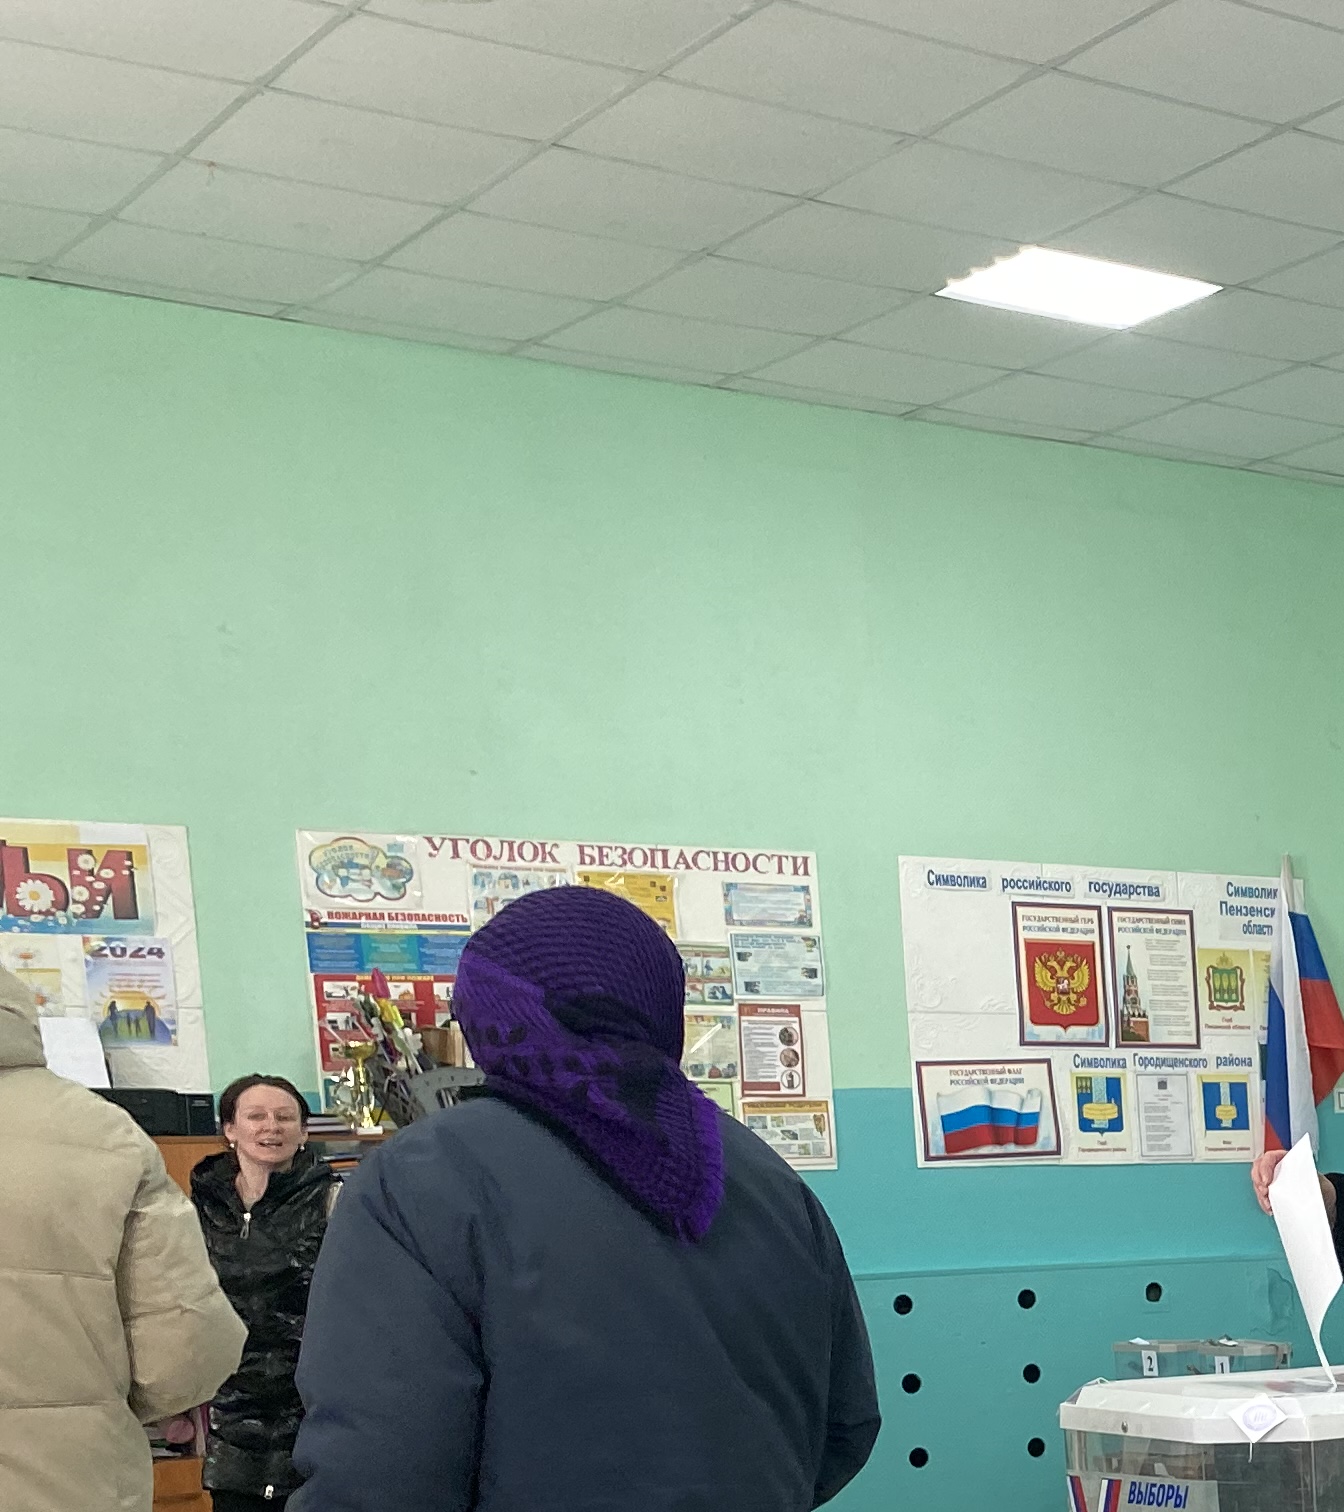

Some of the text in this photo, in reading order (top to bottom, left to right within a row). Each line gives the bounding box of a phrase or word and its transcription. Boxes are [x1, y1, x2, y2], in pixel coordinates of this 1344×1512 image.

[422, 835, 812, 877] УГОЛОК БЕЗОПАСНОСТИ
[927, 869, 1161, 899] Символика российского государства
[1226, 881, 1278, 900] Символик
[327, 910, 468, 923] ПОЖАРНАЯ БЕЗОПАСНОСТЬ
[90, 940, 165, 960] 2024
[1073, 1053, 1252, 1070] Символика Городищенского района
[1147, 1355, 1154, 1372] 2
[1127, 1480, 1189, 1509] ВЫБОРЫ
